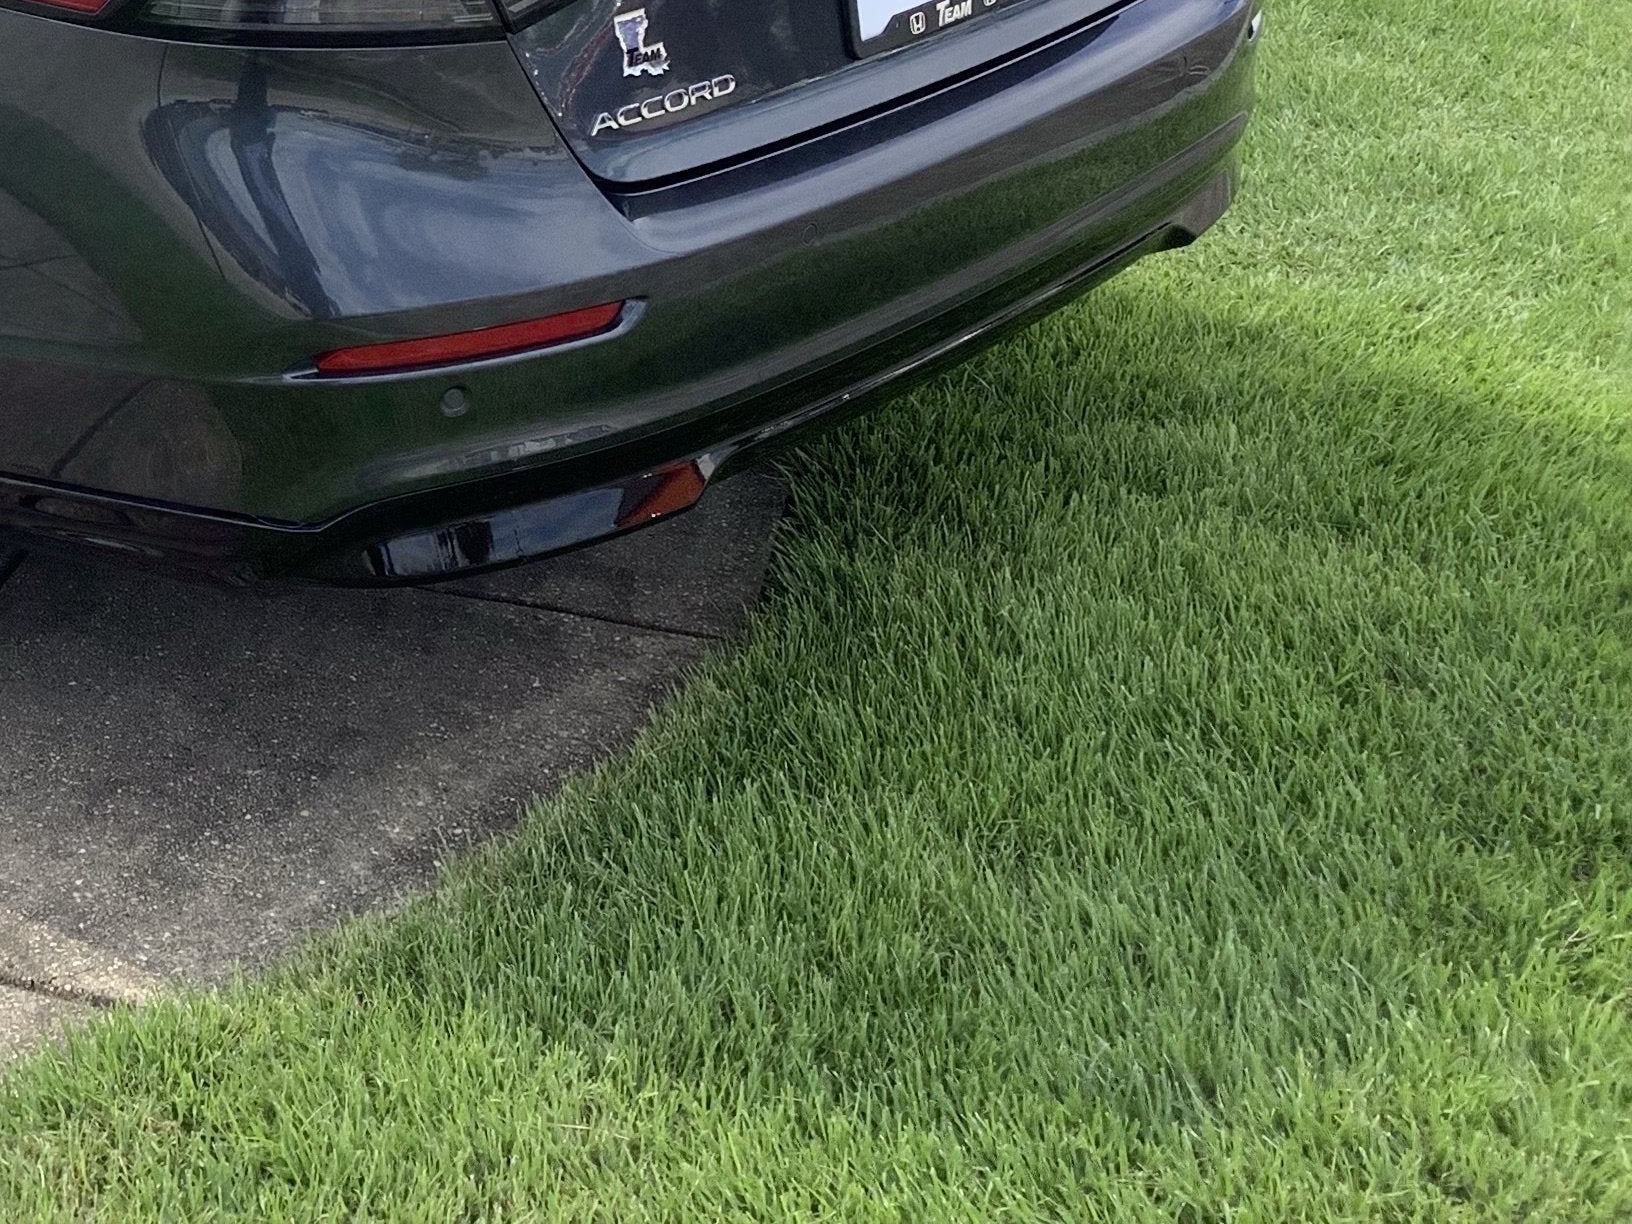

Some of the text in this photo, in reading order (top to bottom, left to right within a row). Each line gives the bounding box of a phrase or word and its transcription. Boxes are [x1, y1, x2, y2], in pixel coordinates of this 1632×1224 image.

[936, 0, 973, 27] TEAM
[626, 47, 662, 67] TEAM
[591, 74, 736, 137] ACCORD
